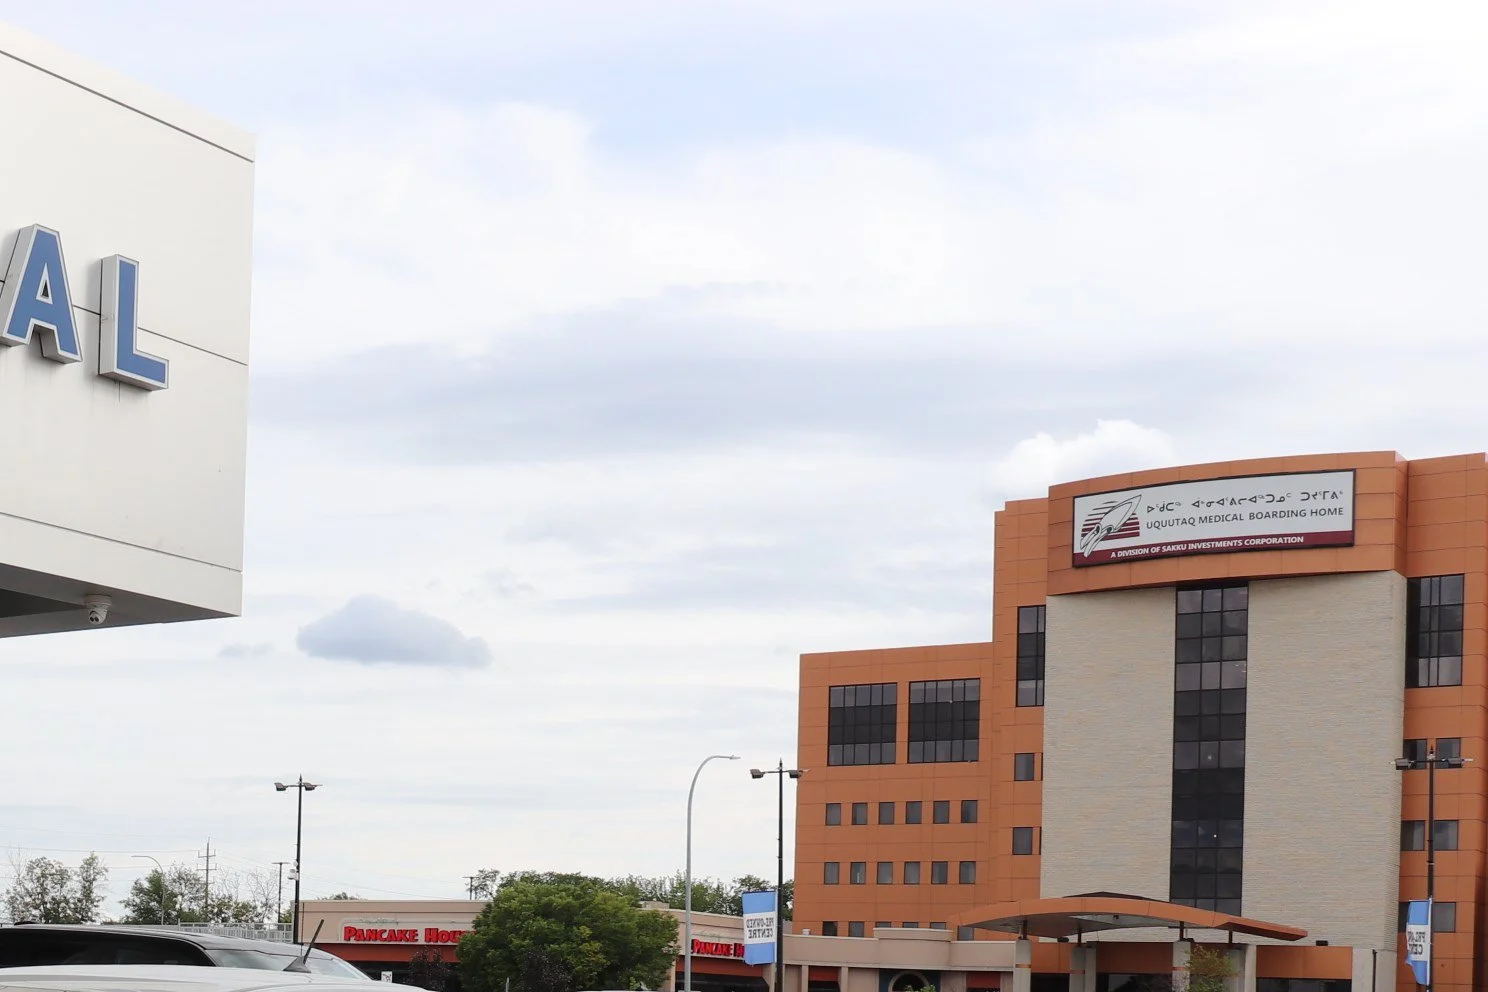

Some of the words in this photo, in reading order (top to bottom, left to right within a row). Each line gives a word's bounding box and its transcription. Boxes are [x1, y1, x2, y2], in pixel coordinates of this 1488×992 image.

[1146, 516, 1196, 530] UQUUTAQ
[1198, 512, 1244, 524] MEDICAL
[1248, 508, 1307, 520] BOARDING
[1310, 506, 1344, 517] HOME
[1117, 547, 1149, 557] DIVISION
[1150, 546, 1161, 554] OF
[1162, 543, 1187, 552] SAKKU
[1188, 539, 1243, 550] INVESTMENTS
[1244, 536, 1304, 546] CORPORATION
[343, 926, 419, 942] PANCAKE
[424, 927, 475, 943] HOU
[691, 939, 733, 957] PANCAKE
